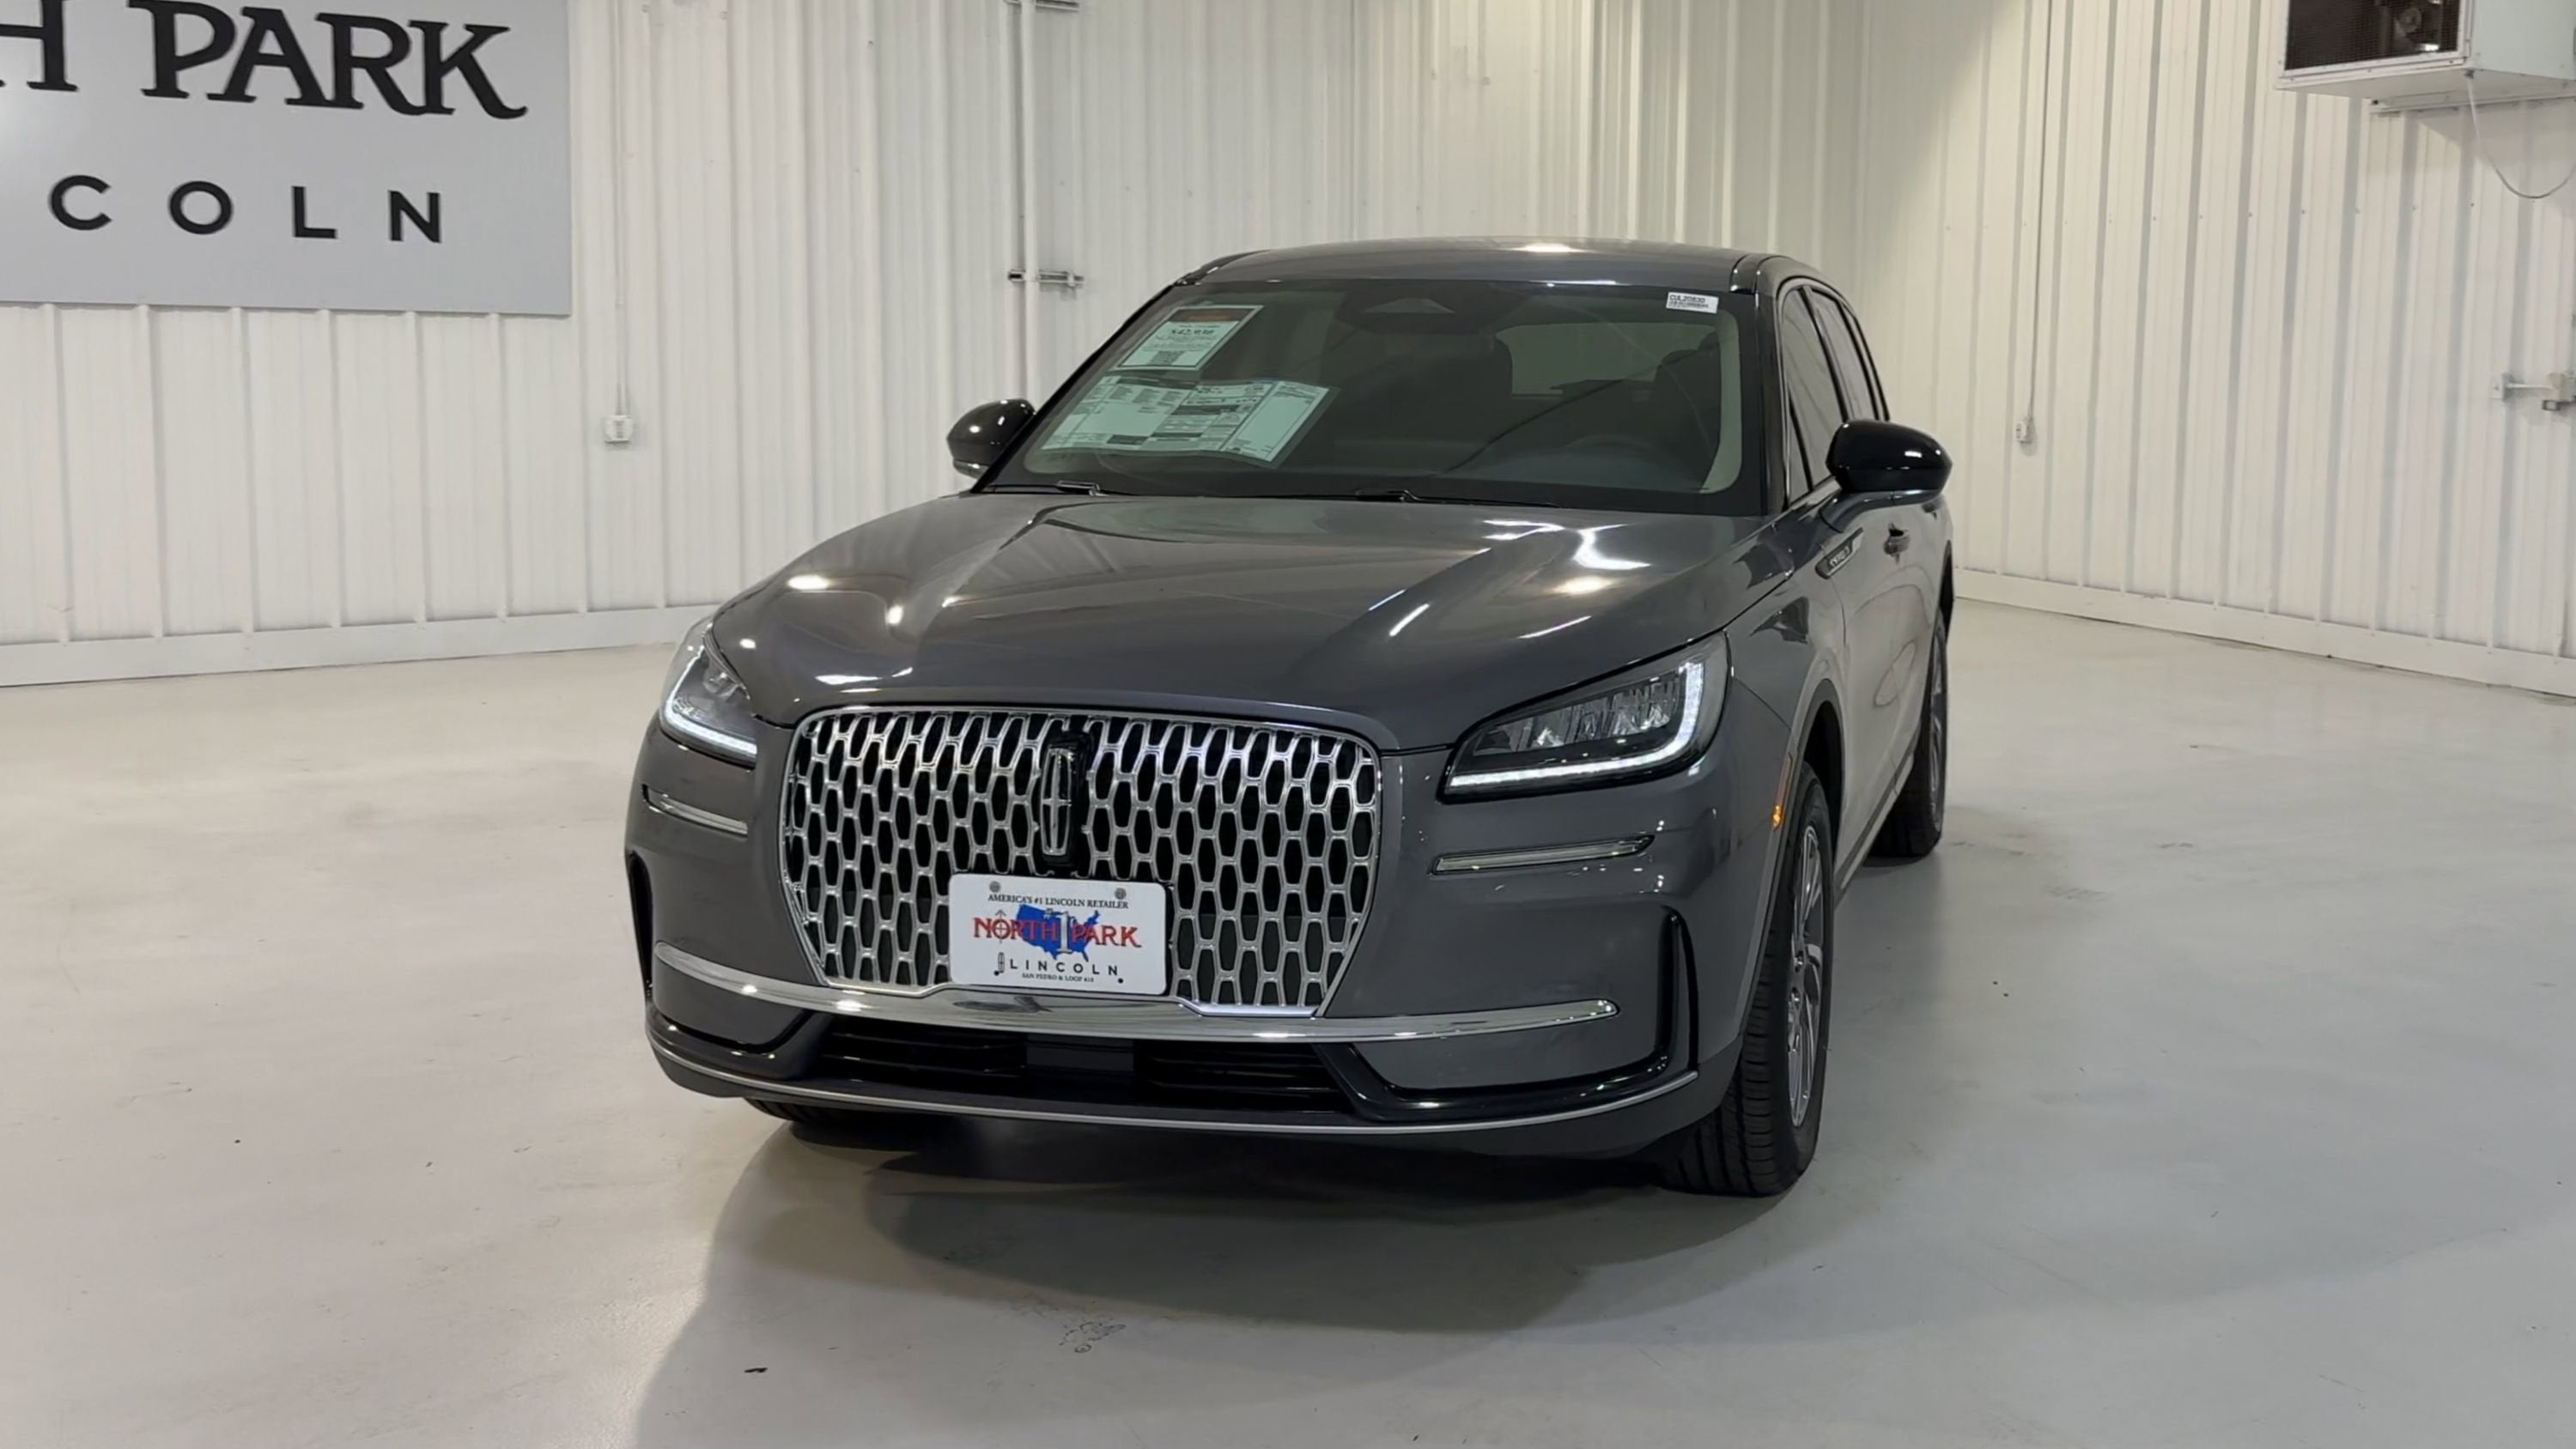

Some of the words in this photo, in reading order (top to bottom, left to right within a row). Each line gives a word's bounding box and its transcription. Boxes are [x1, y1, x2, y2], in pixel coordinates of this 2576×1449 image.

[127, 0, 529, 119] PARK
[48, 174, 442, 243] COLN
[987, 894, 1032, 904] AMERICA'S
[1045, 897, 1085, 907] LINCOLN
[1086, 900, 1129, 909] RETAILER
[973, 916, 1059, 942] NORTH
[1071, 922, 1143, 948] PARK
[1010, 958, 1118, 976] LINCOLN
